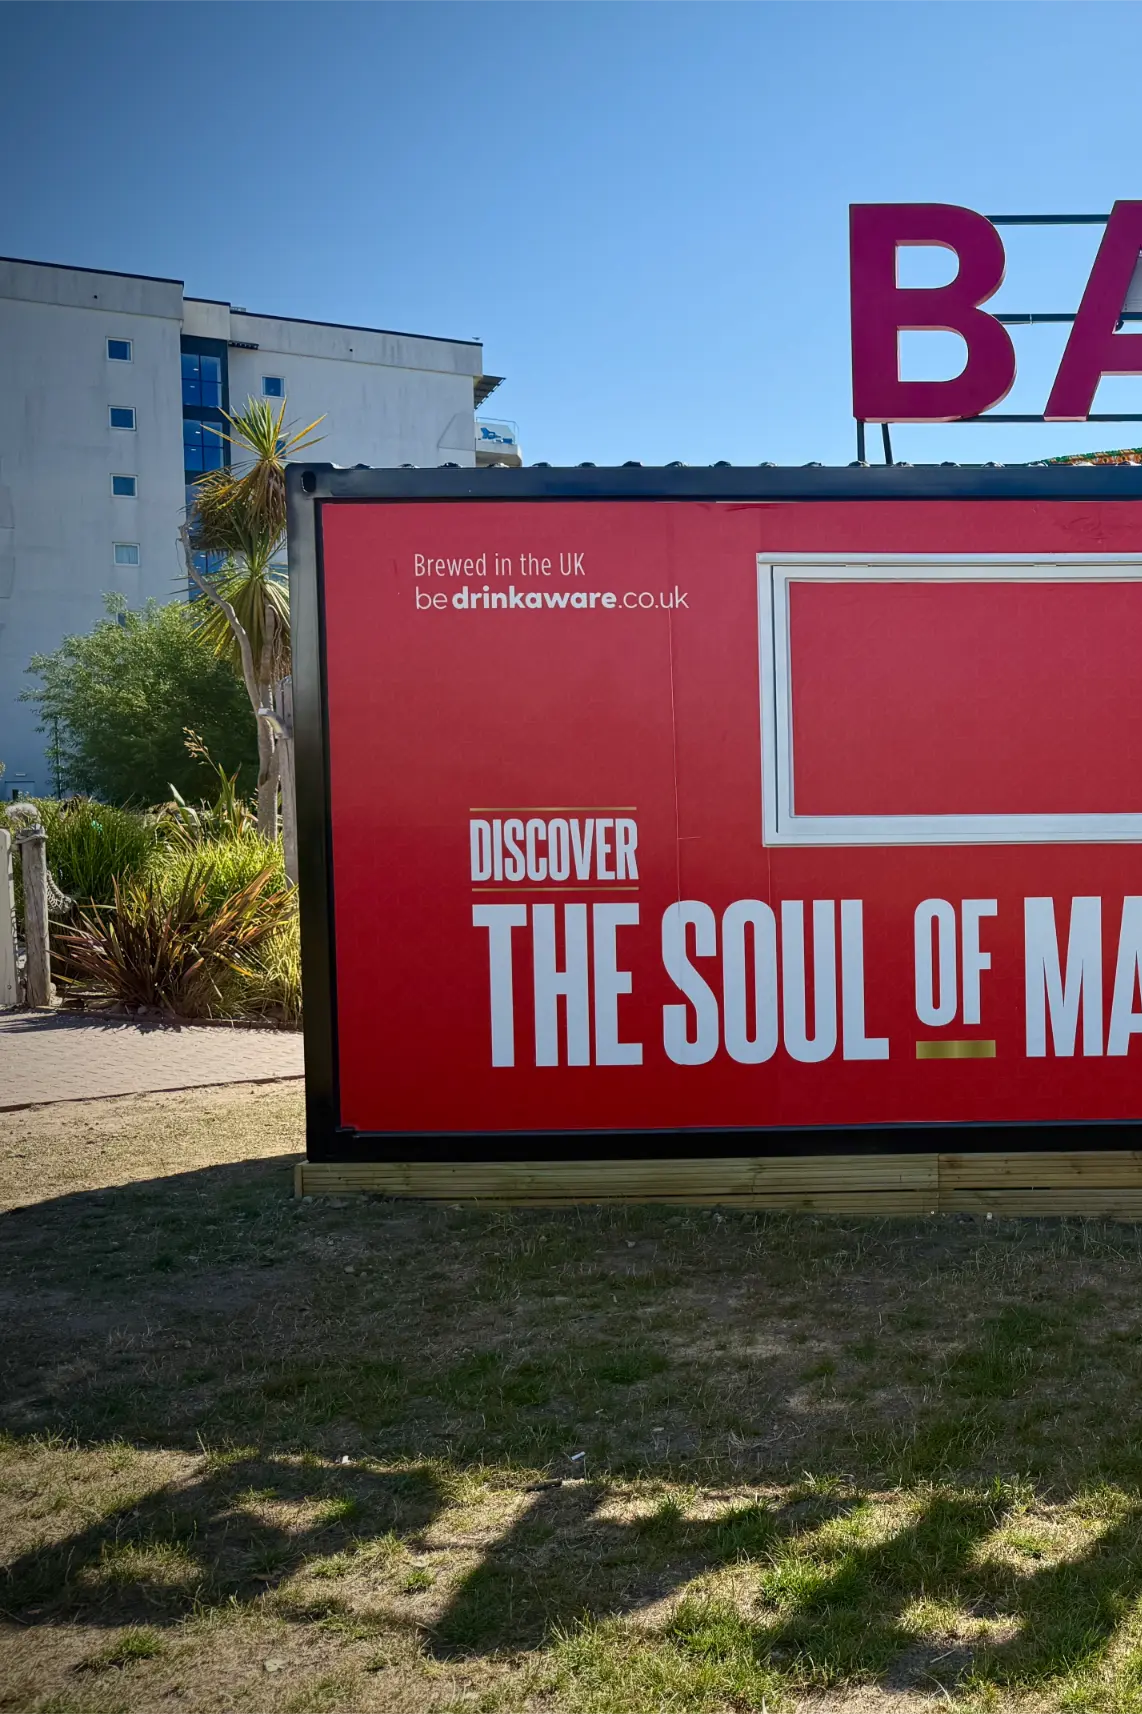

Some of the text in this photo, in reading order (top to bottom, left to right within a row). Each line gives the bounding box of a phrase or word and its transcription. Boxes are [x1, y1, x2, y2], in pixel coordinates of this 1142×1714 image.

[414, 552, 586, 577] Brewed in the UK
[470, 817, 639, 882] DISCOVER
[472, 903, 643, 1068] THE
[661, 899, 889, 1066] SOUL
[914, 898, 998, 1027] OF
